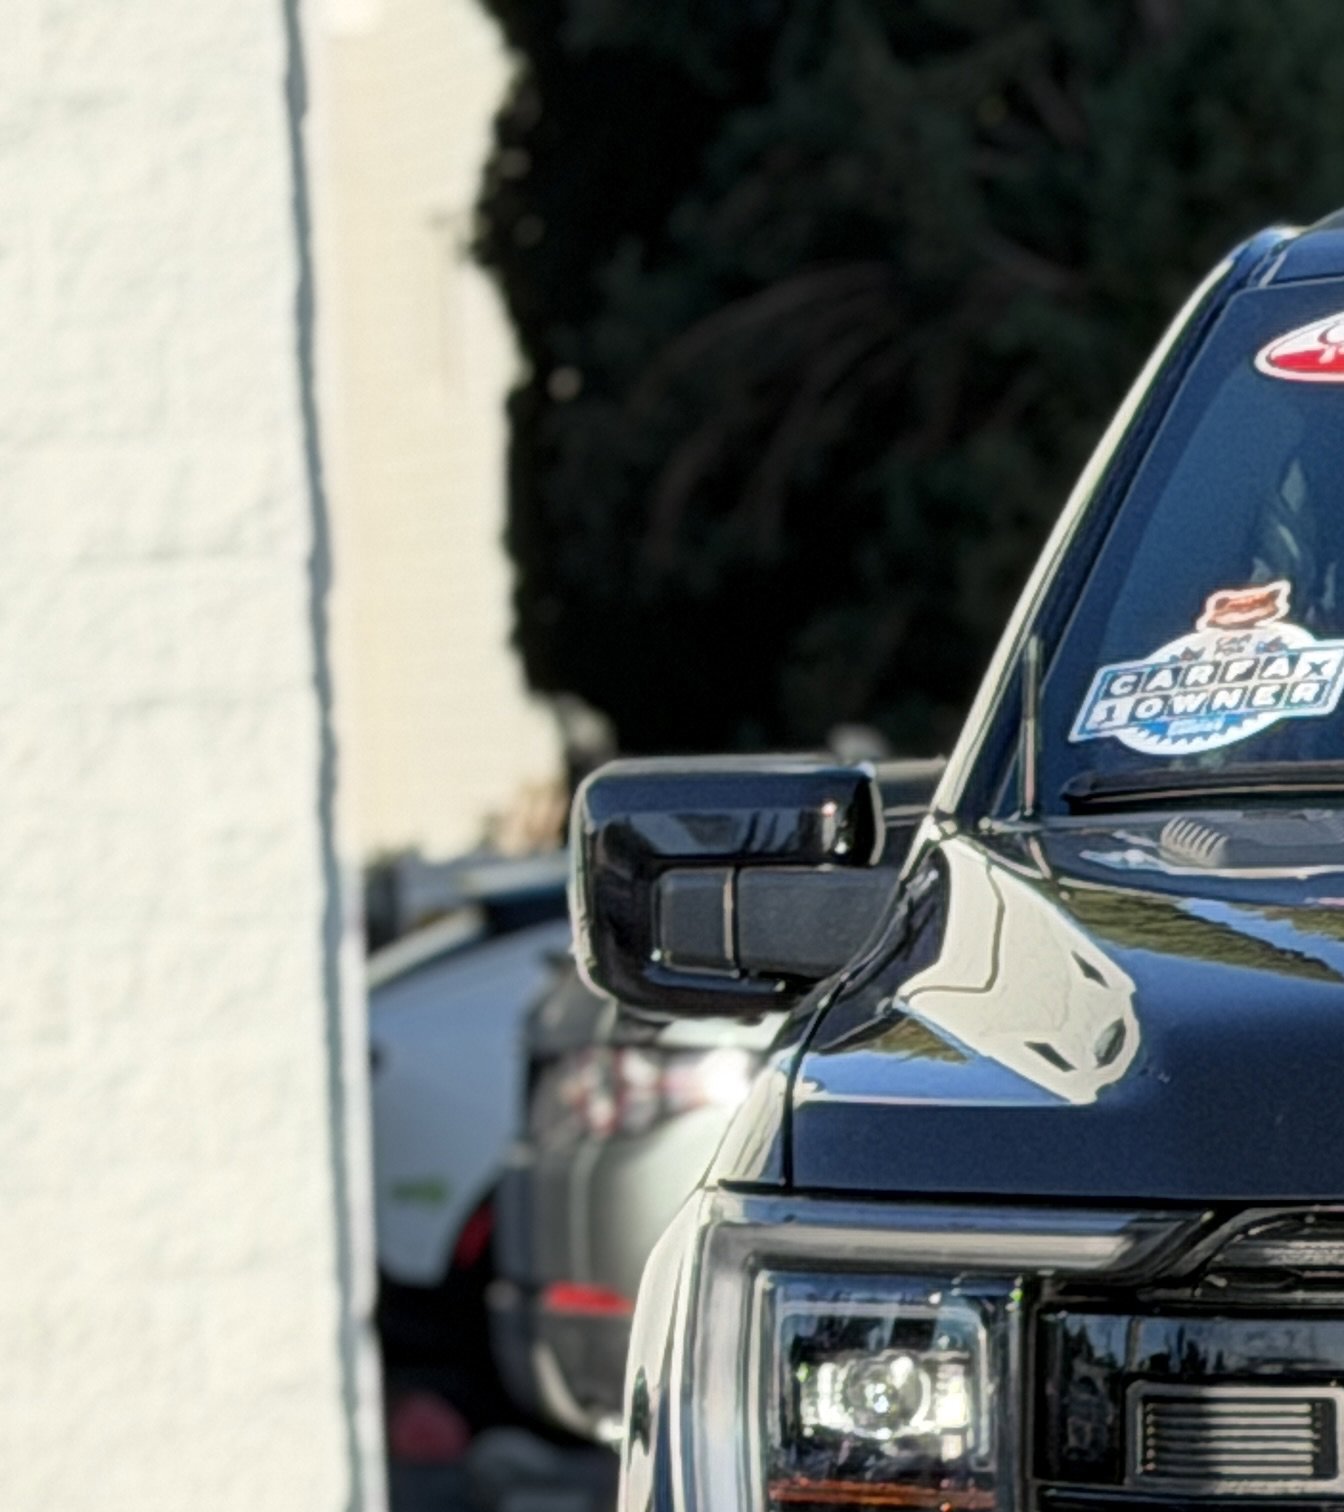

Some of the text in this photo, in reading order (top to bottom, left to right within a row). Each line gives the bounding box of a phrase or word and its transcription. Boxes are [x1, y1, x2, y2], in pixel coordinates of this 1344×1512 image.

[1109, 656, 1332, 697] CARFAX
[1102, 682, 1320, 724] 1 OWNER
